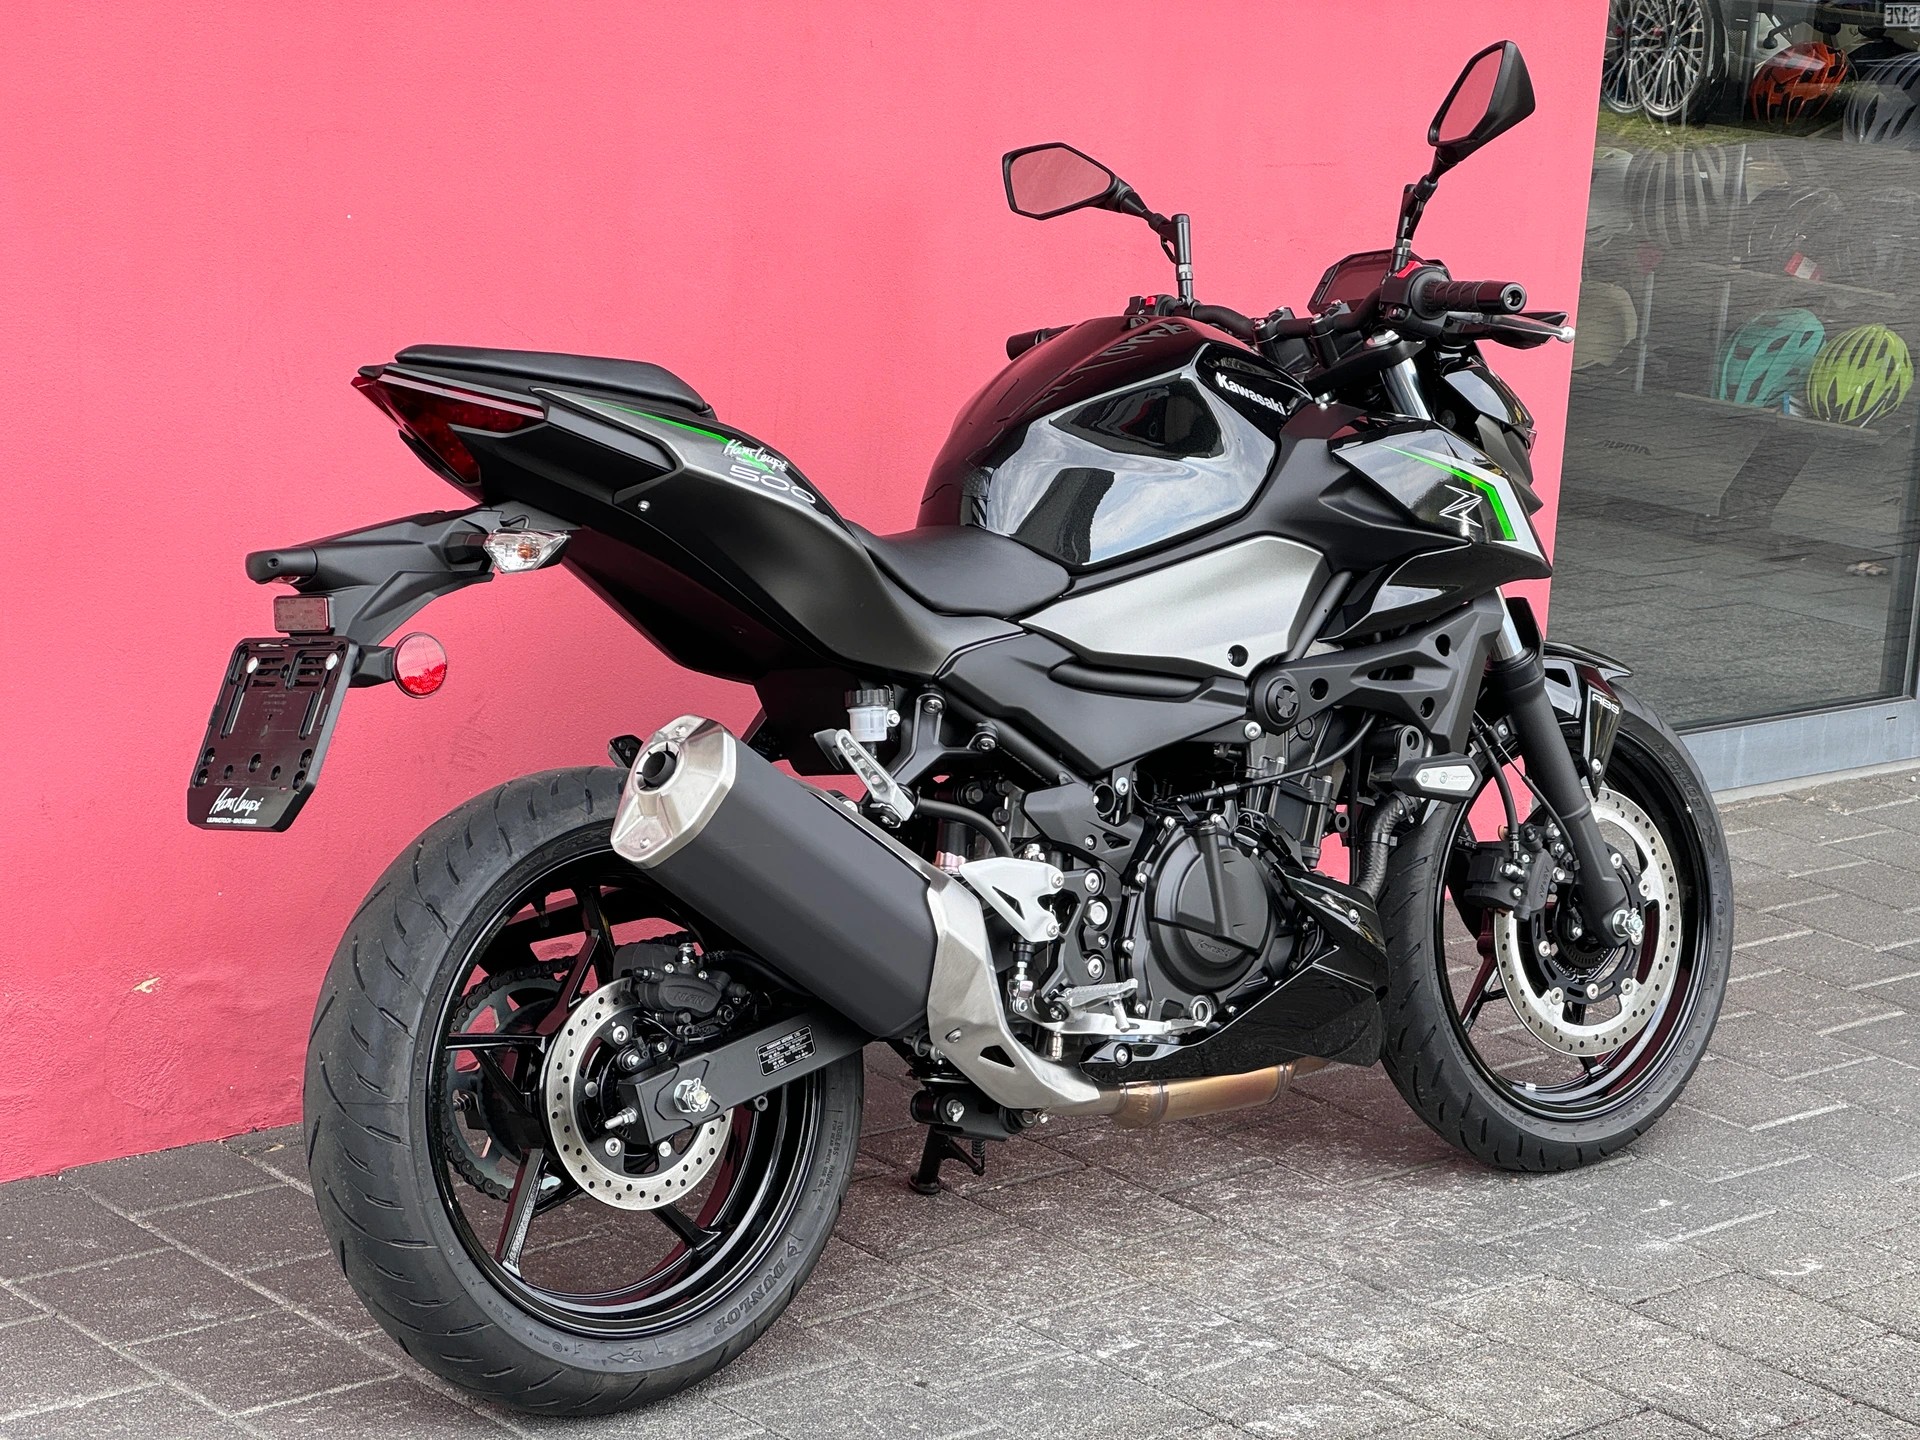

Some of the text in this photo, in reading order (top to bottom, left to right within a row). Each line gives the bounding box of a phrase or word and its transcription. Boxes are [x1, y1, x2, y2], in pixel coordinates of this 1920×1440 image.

[1215, 371, 1287, 416] Kawasaki
[723, 439, 757, 457] Hans
[729, 464, 816, 504] 500
[1592, 693, 1620, 715] ABS
[209, 787, 238, 815] Hans
[823, 1120, 843, 1187] TUBELESS RADIAL
[713, 1257, 788, 1335] DUNLOP
